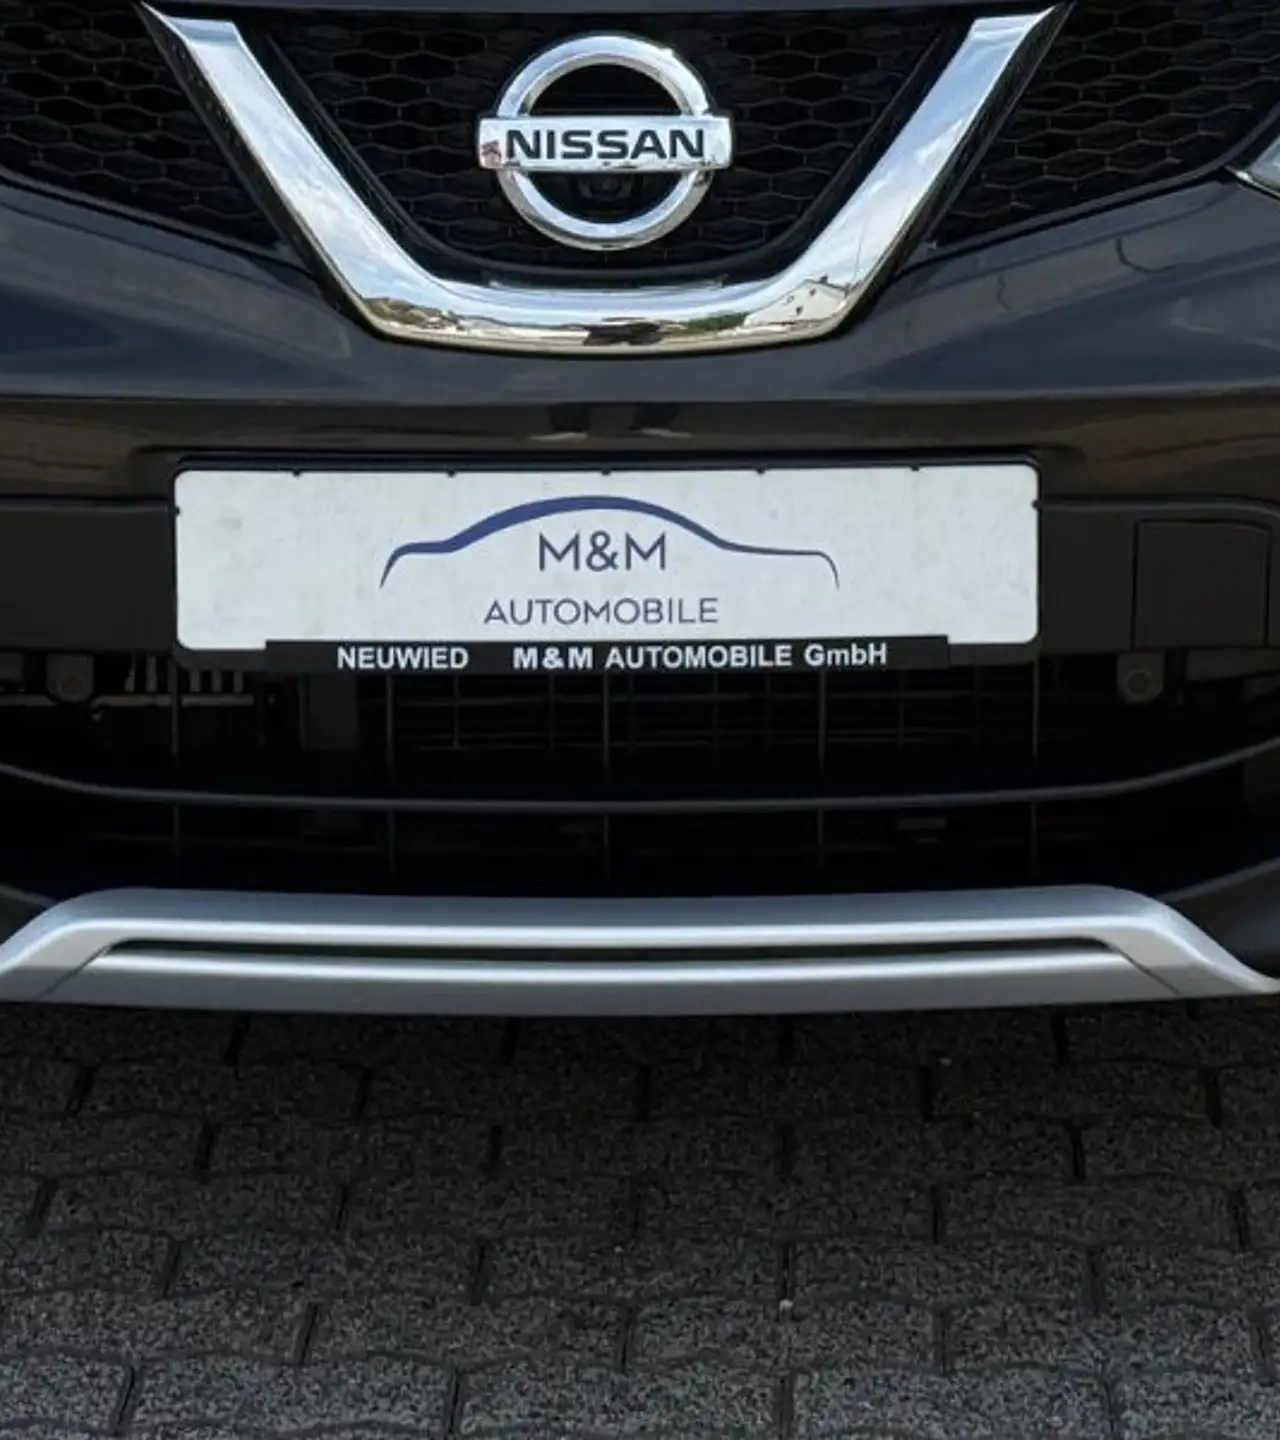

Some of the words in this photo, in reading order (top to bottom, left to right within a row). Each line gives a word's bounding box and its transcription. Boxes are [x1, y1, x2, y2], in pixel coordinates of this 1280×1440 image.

[504, 128, 706, 160] NISSAN
[538, 529, 667, 573] M&M
[482, 596, 720, 627] AUTOMOBILE
[337, 645, 470, 670] NEUWIED
[513, 645, 594, 670] M&M
[604, 643, 793, 669] AUTOMOBILE
[804, 641, 888, 667] GmbH
